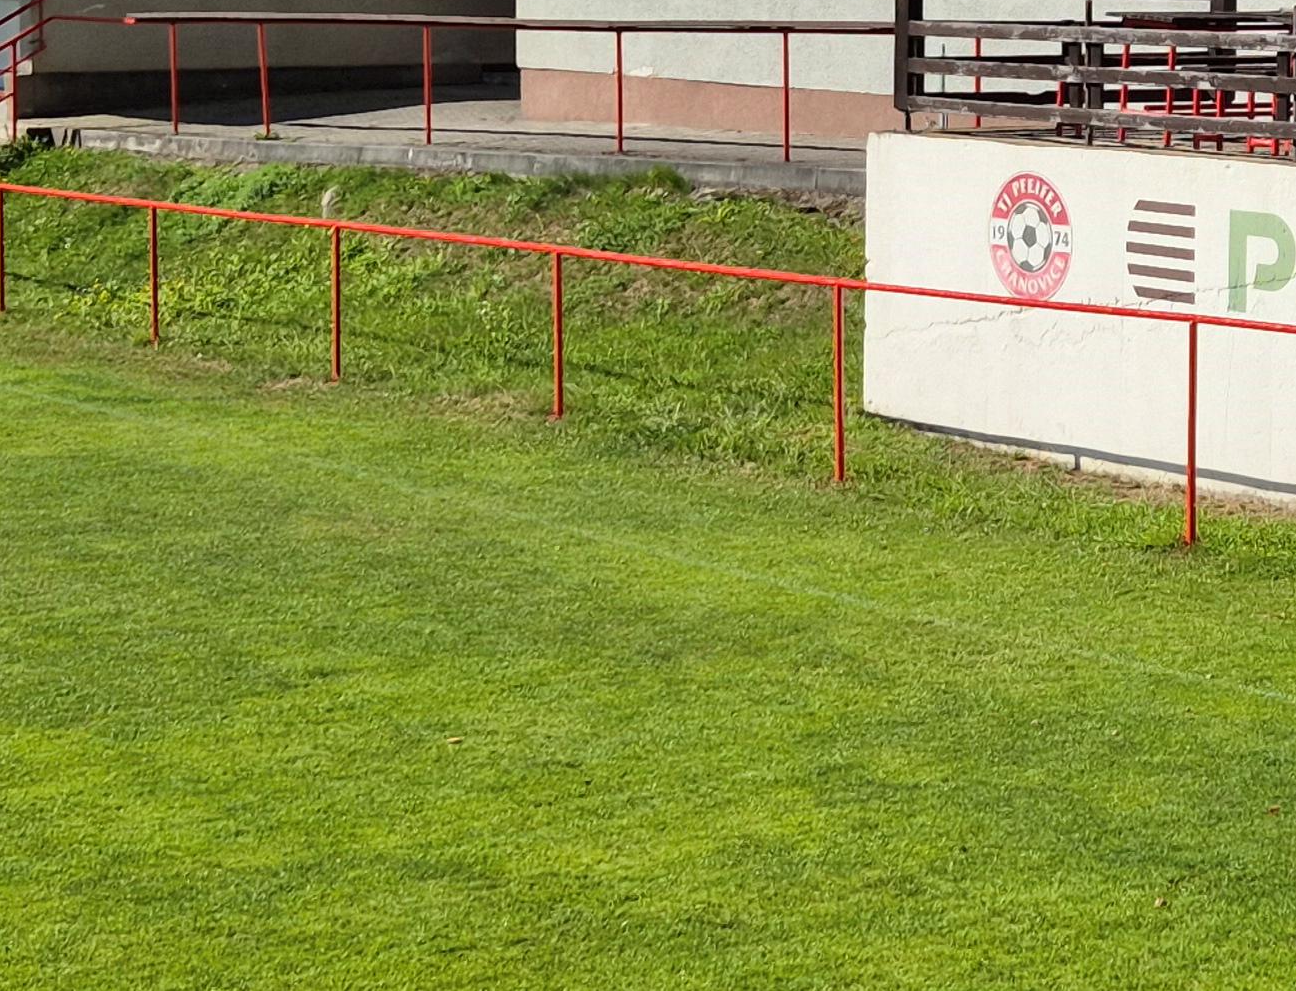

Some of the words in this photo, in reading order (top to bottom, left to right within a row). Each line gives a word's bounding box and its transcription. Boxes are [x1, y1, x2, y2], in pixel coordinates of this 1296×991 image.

[1011, 177, 1063, 218] PFEIFER
[992, 225, 1006, 240] 19
[1054, 230, 1070, 248] 74
